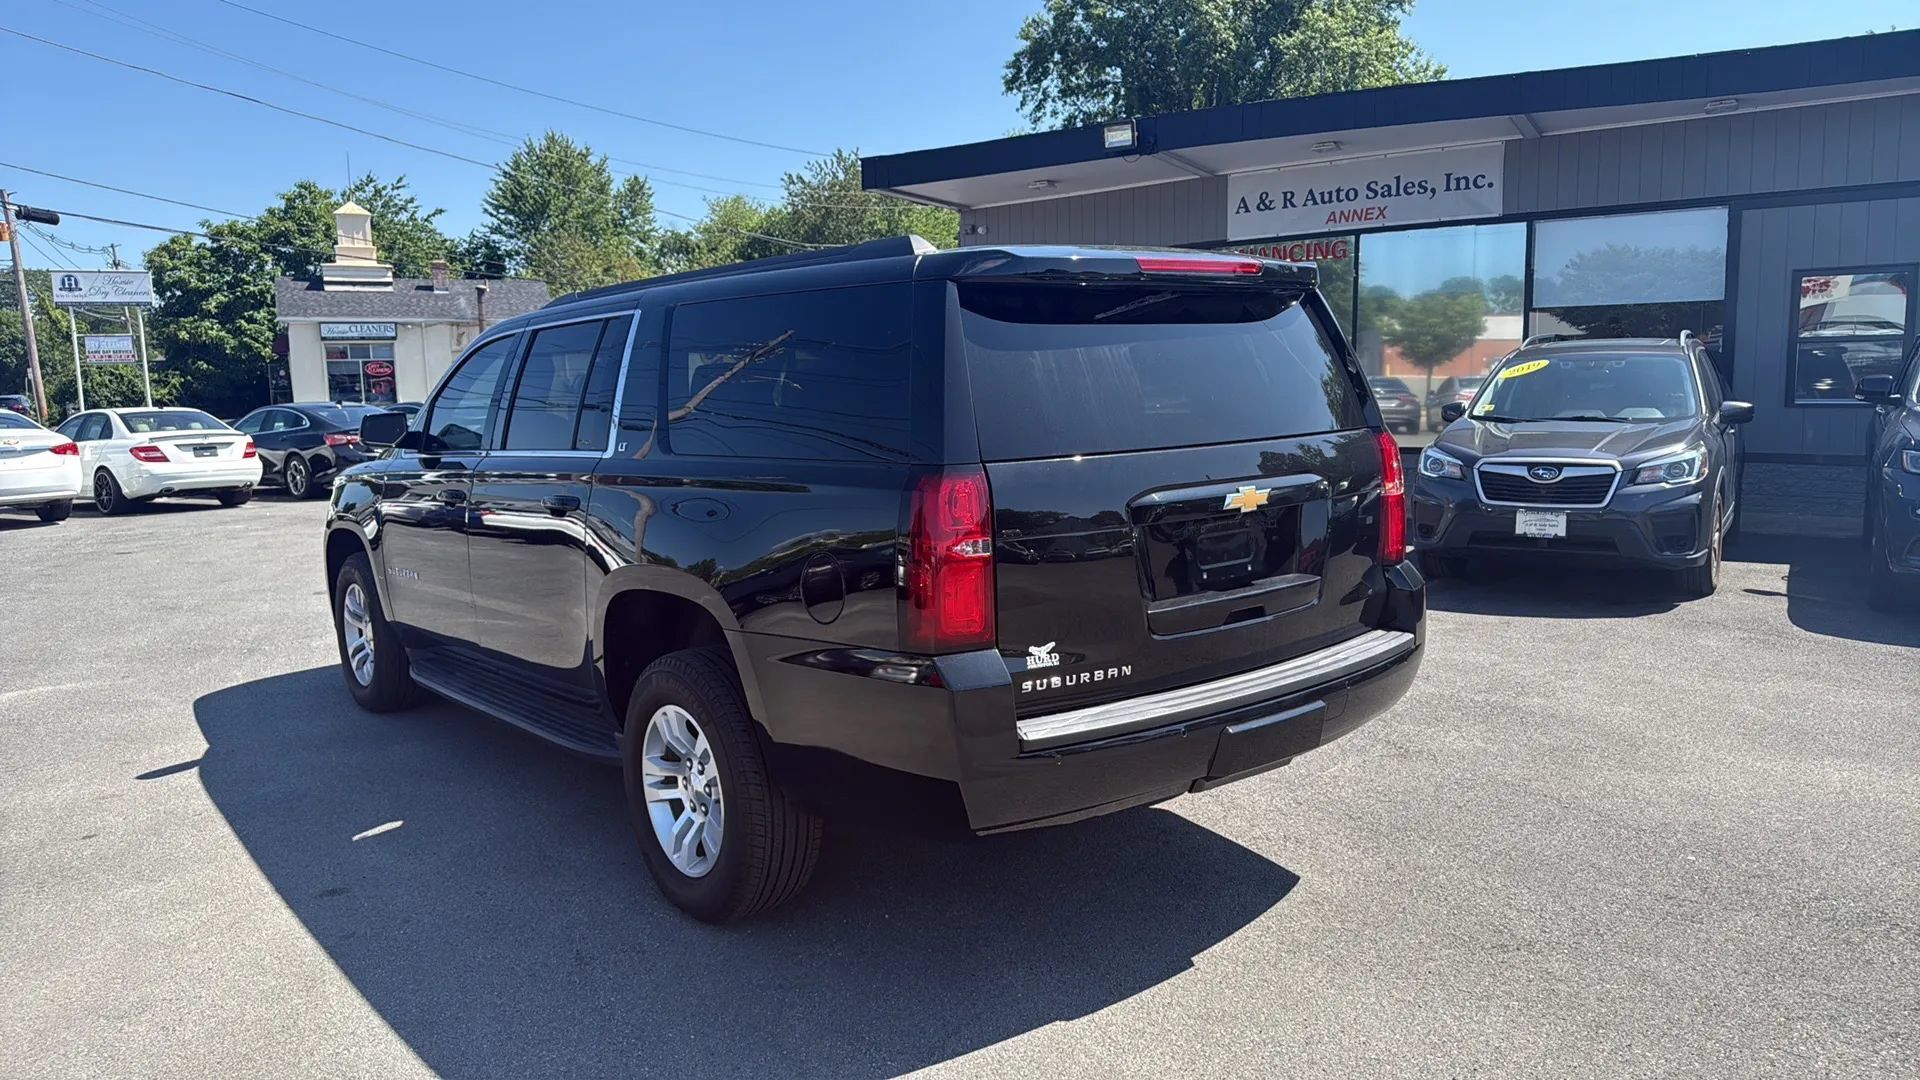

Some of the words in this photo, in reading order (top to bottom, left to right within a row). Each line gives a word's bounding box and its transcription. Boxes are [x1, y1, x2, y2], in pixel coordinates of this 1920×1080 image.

[1235, 197, 1251, 214] A
[1256, 191, 1276, 212] &
[1281, 190, 1298, 209] R
[1302, 185, 1359, 207] Auto
[1365, 175, 1437, 200] Sales,
[1443, 172, 1495, 193] Inc.
[1325, 205, 1389, 225] ANNEX
[88, 286, 110, 299] Dry
[112, 285, 150, 297] Cleaners
[348, 324, 394, 334] CLEANERS
[1508, 362, 1541, 375] 2019
[1026, 653, 1060, 666] HURD
[1021, 665, 1132, 693] SUBURBAN
